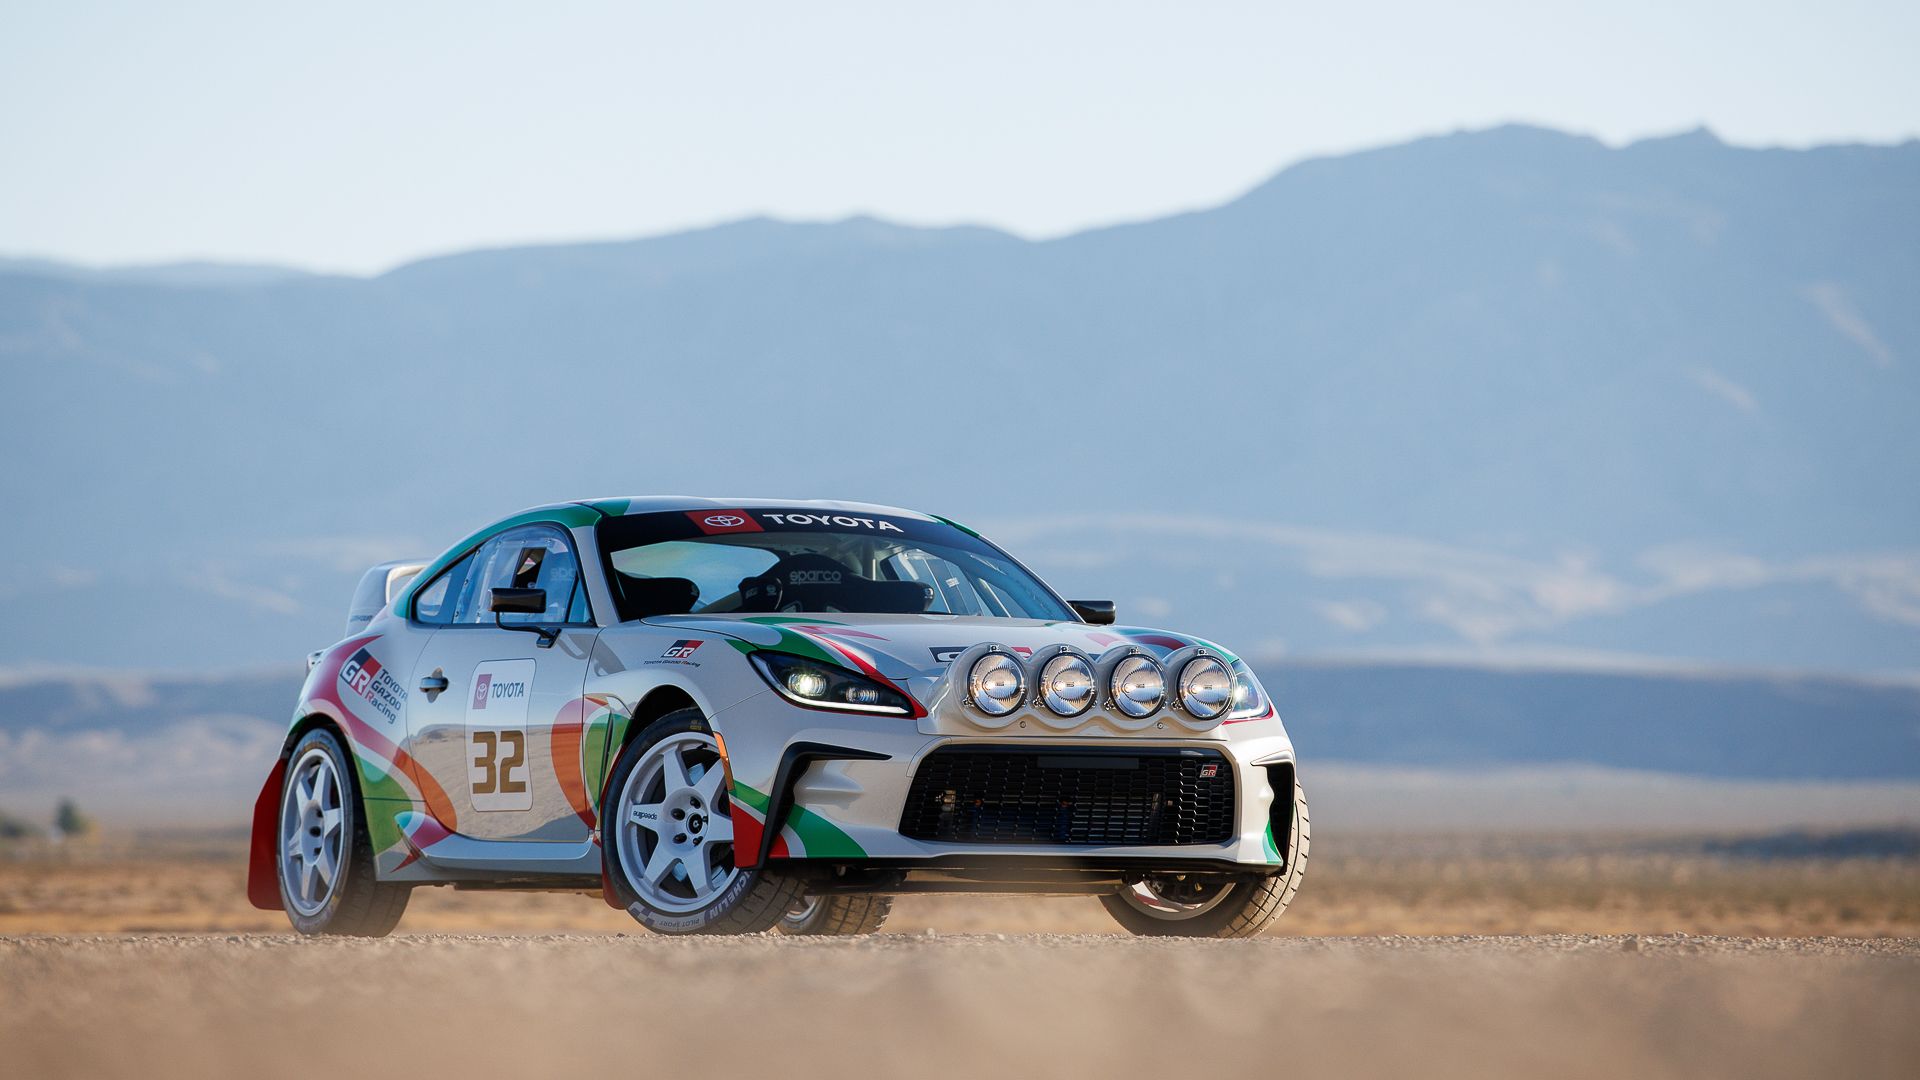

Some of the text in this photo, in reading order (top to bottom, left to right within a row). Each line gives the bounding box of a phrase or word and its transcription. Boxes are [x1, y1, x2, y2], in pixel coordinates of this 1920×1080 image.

[763, 514, 904, 533] TOYOTA
[790, 570, 841, 584] sparco
[664, 647, 695, 657] GR
[342, 660, 371, 694] GR
[380, 669, 408, 700] TOYOTA
[491, 682, 524, 698] TOYOTA
[365, 690, 396, 725] Racing
[371, 680, 402, 711] GAZOO
[472, 730, 526, 794] 32
[709, 870, 754, 919] ICHELIN
